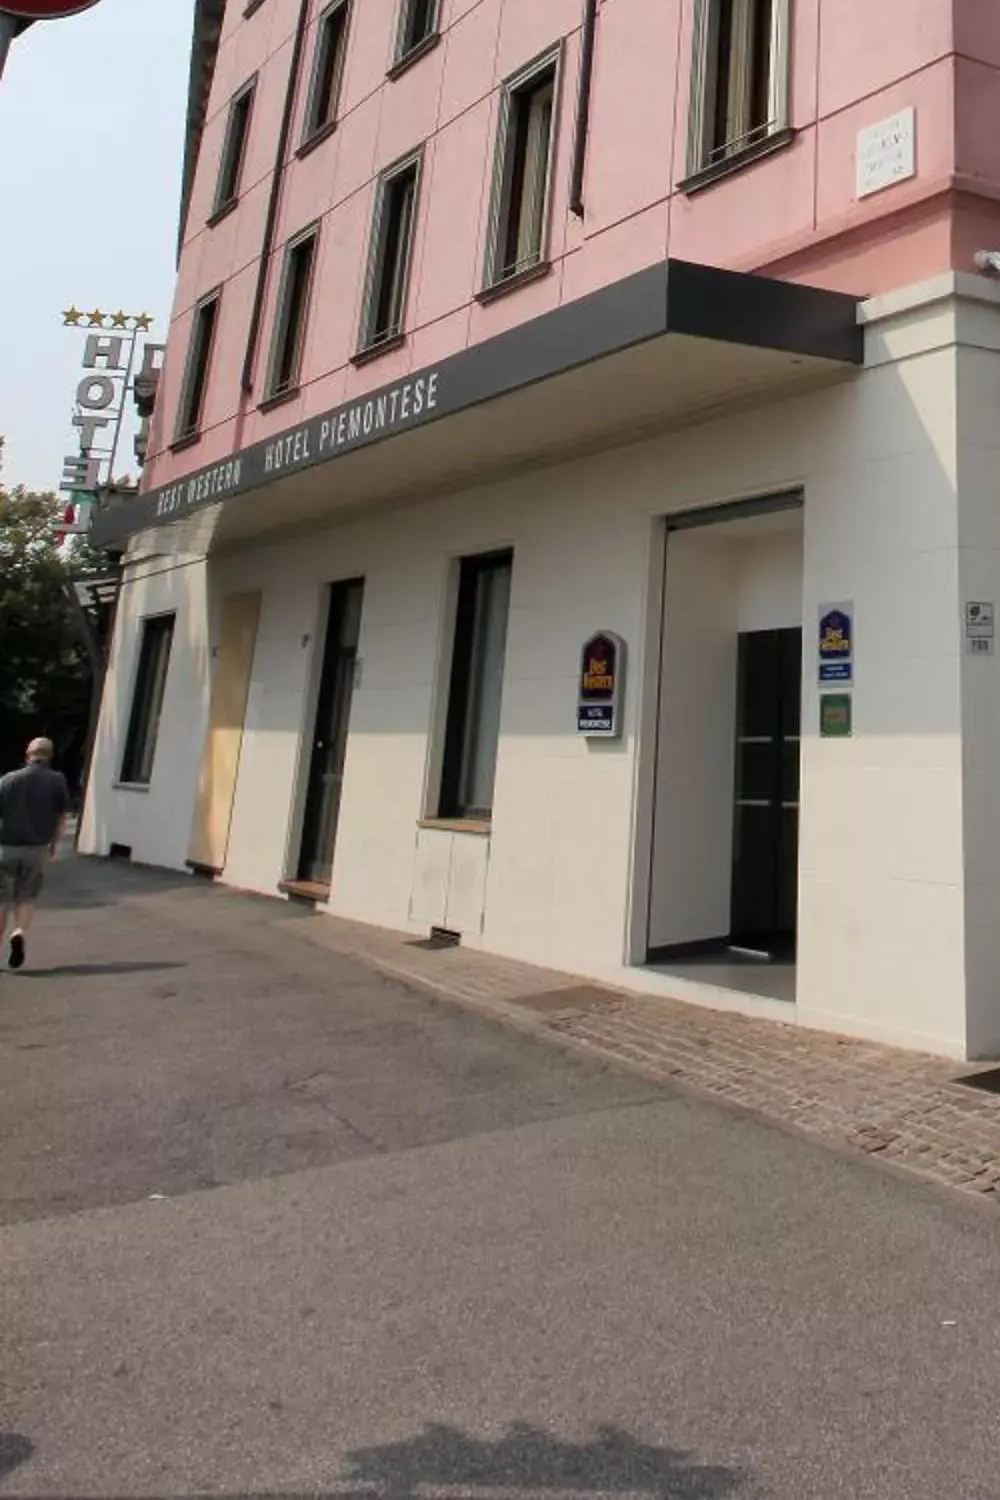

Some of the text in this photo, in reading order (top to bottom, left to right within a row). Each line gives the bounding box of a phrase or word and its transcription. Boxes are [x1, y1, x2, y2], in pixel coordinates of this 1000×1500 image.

[187, 460, 242, 503] WESTERN
[264, 426, 310, 472] HOTEL
[319, 372, 439, 451] PIEMONTESE
